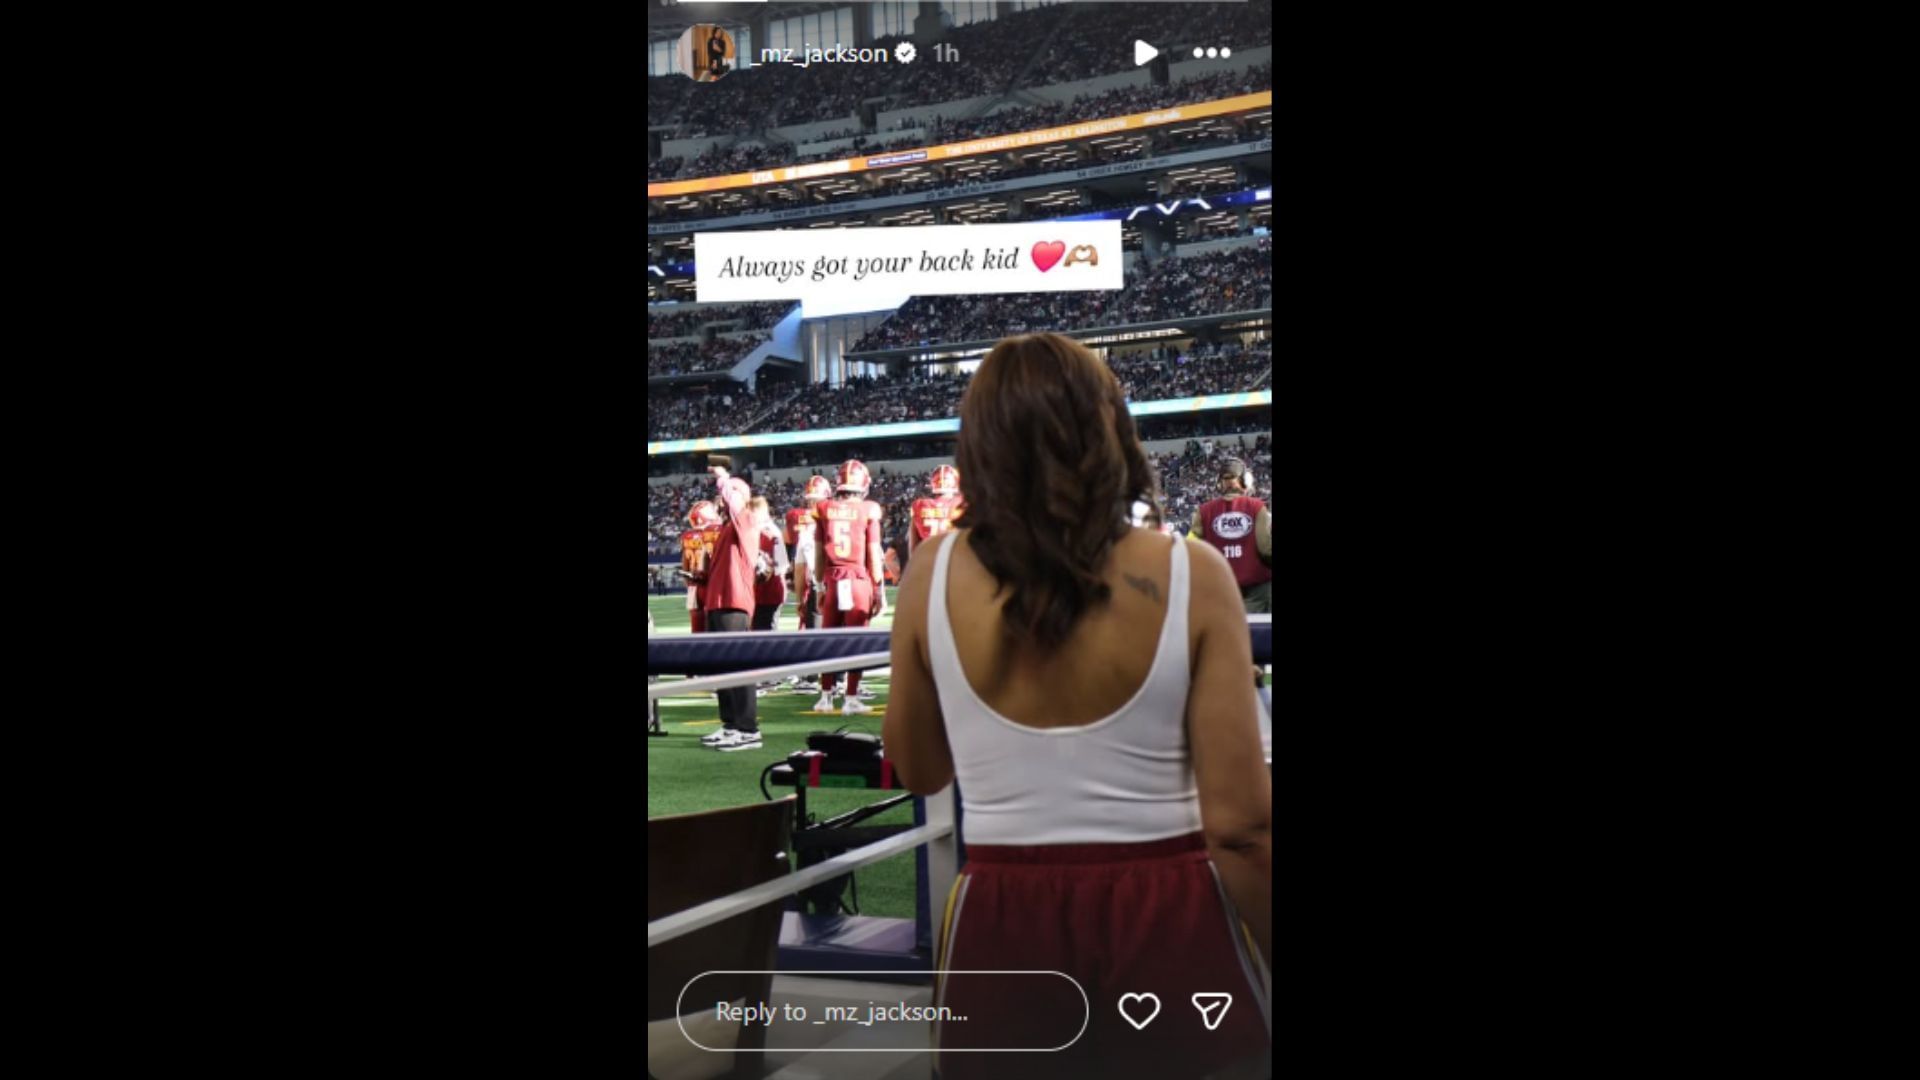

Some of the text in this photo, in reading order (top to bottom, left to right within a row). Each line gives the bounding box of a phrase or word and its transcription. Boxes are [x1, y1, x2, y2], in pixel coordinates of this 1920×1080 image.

[1221, 516, 1244, 528] FOX
[832, 520, 852, 558] 5
[1223, 544, 1243, 558] 116
